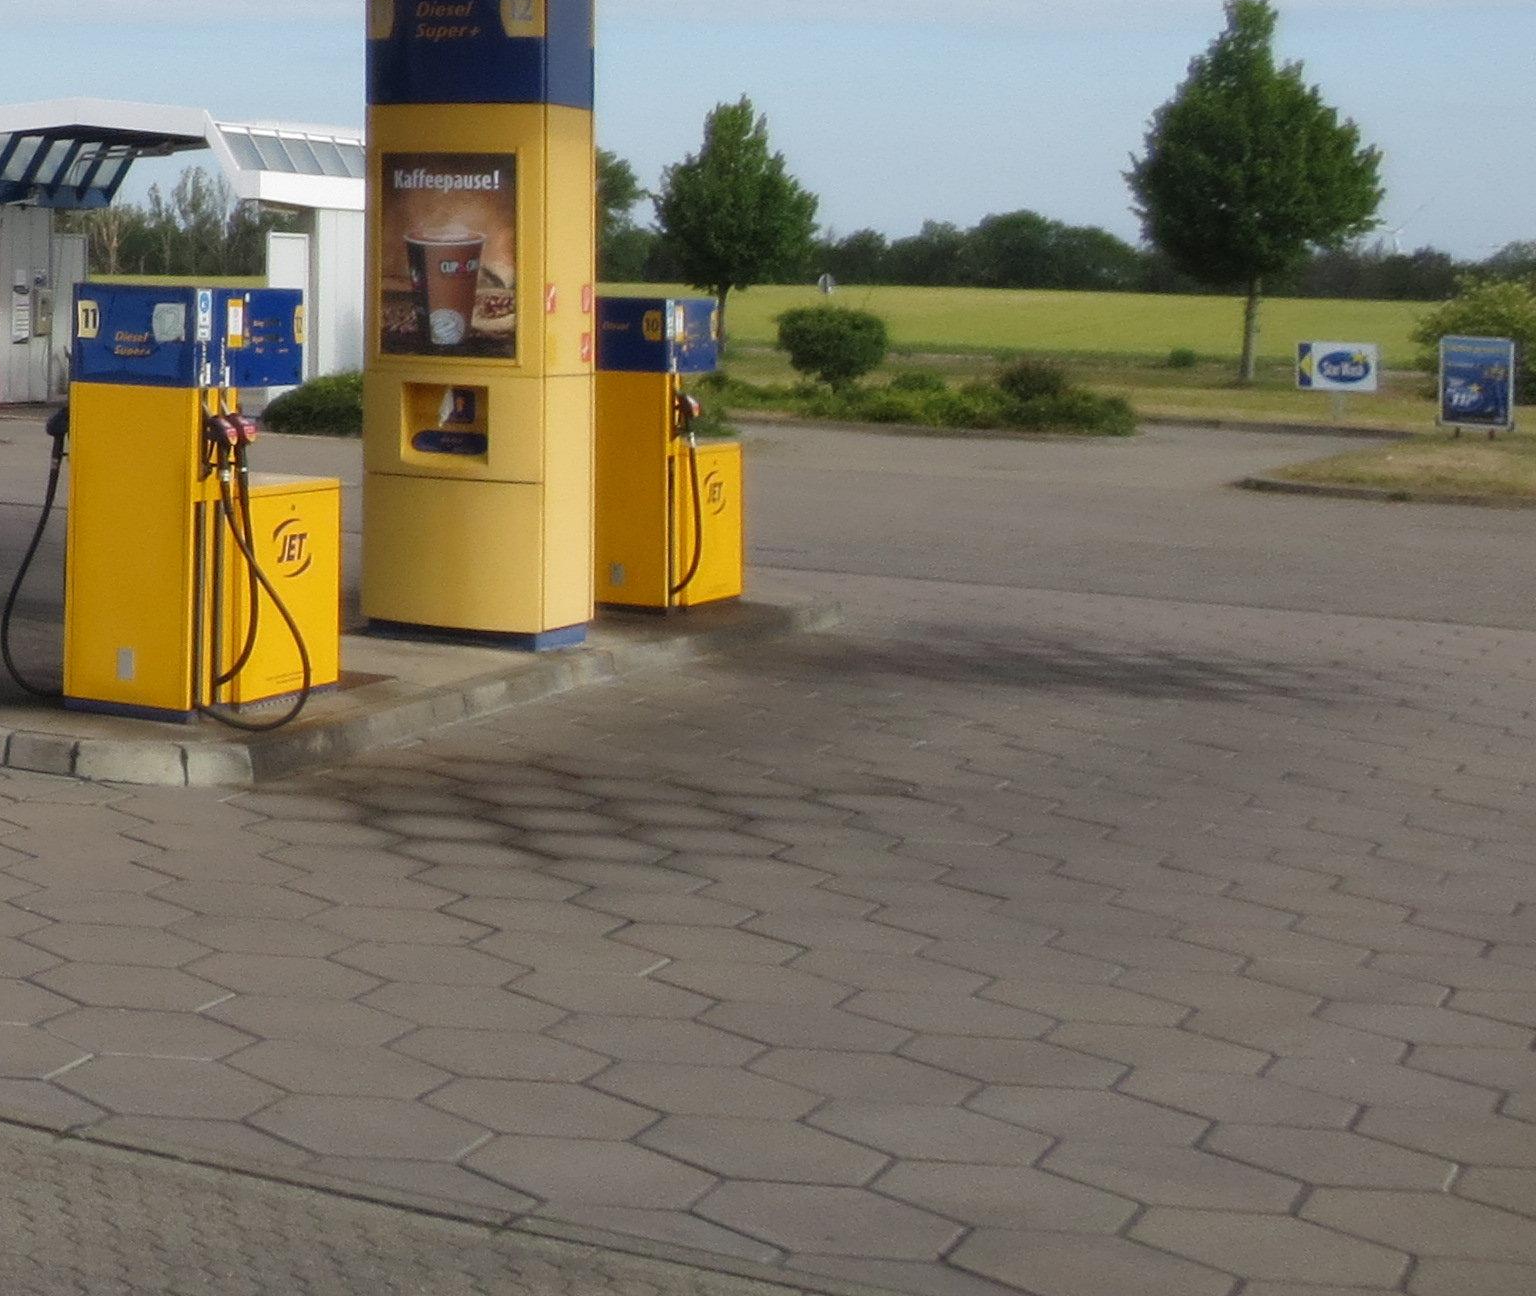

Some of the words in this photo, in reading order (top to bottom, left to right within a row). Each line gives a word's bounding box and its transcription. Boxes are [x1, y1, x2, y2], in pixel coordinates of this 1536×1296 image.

[416, 0, 475, 17] Diesel
[415, 23, 480, 41] Super+
[393, 168, 501, 193] Kaffeepause!
[82, 308, 97, 329] 11
[114, 331, 148, 343] Diesel
[707, 481, 724, 504] JET
[277, 533, 308, 563] JET
